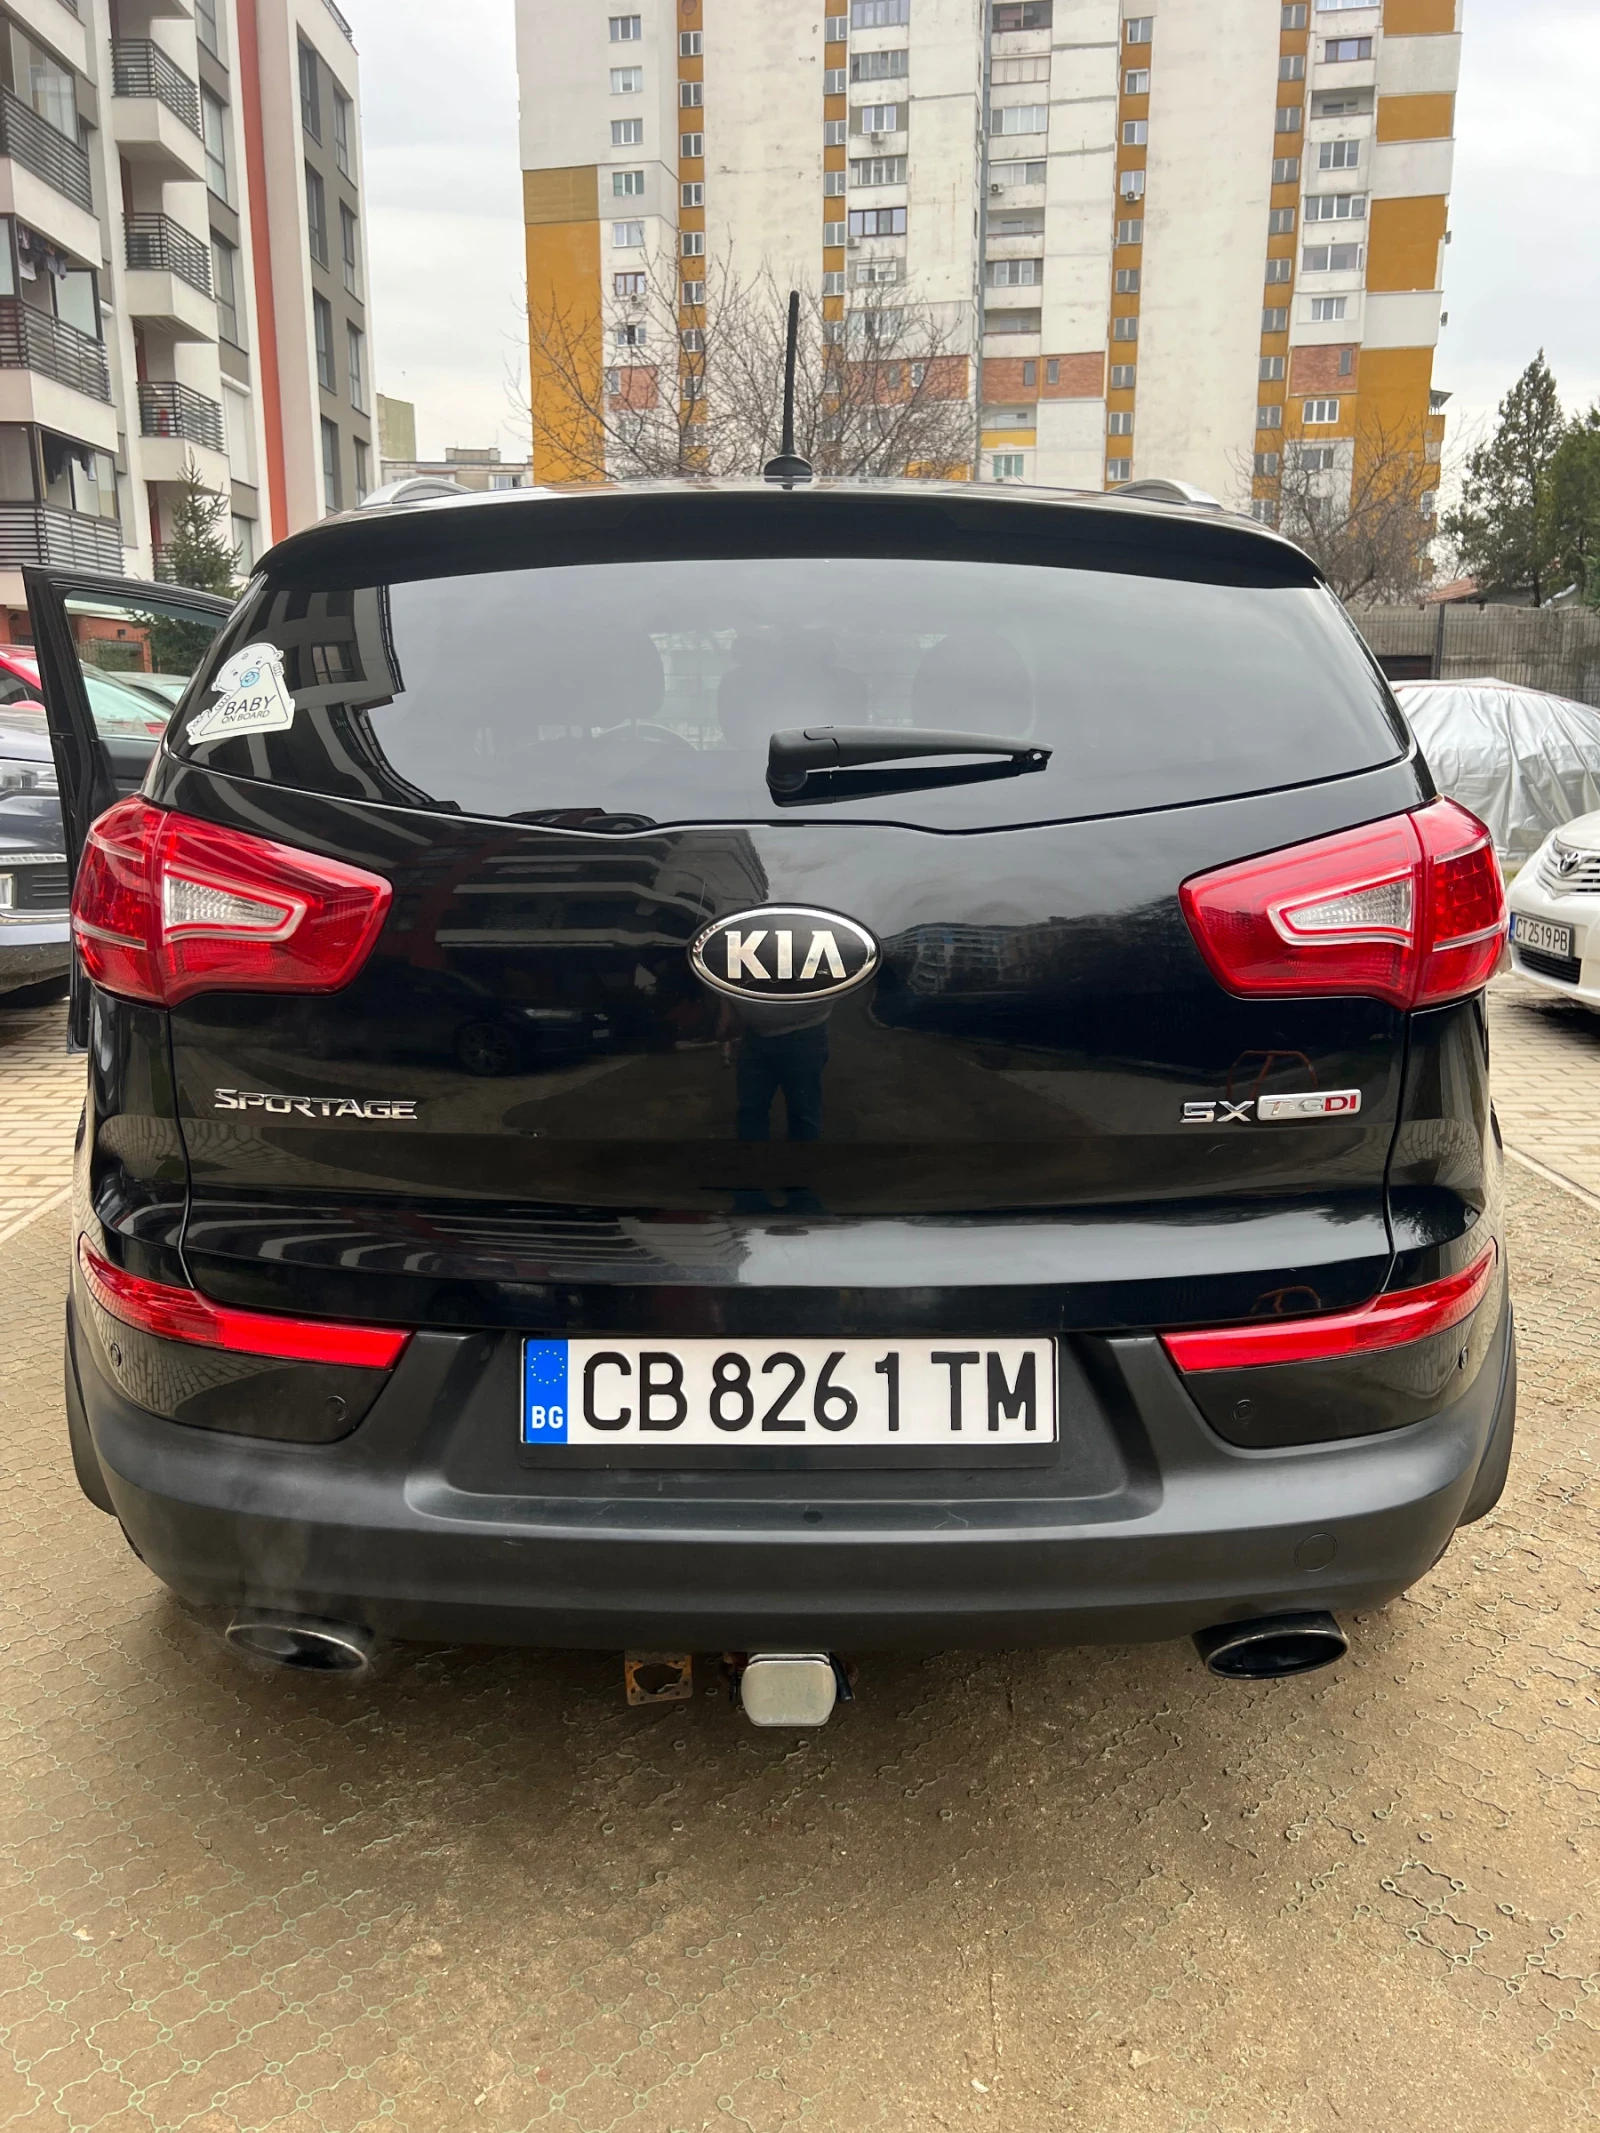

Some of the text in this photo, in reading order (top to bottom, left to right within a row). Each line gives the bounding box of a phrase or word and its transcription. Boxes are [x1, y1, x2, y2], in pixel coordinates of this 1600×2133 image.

[221, 709, 270, 724] ON BOARD
[224, 694, 277, 716] BABY
[1515, 918, 1529, 939] CT
[1528, 922, 1552, 949] 2519
[1552, 929, 1568, 952] PB
[724, 930, 847, 979] KIA
[214, 1088, 418, 1120] SPORTAGE
[1180, 1100, 1255, 1124] SX
[583, 1351, 1037, 1432] CB 8261 TM
[531, 1405, 564, 1430] BG
